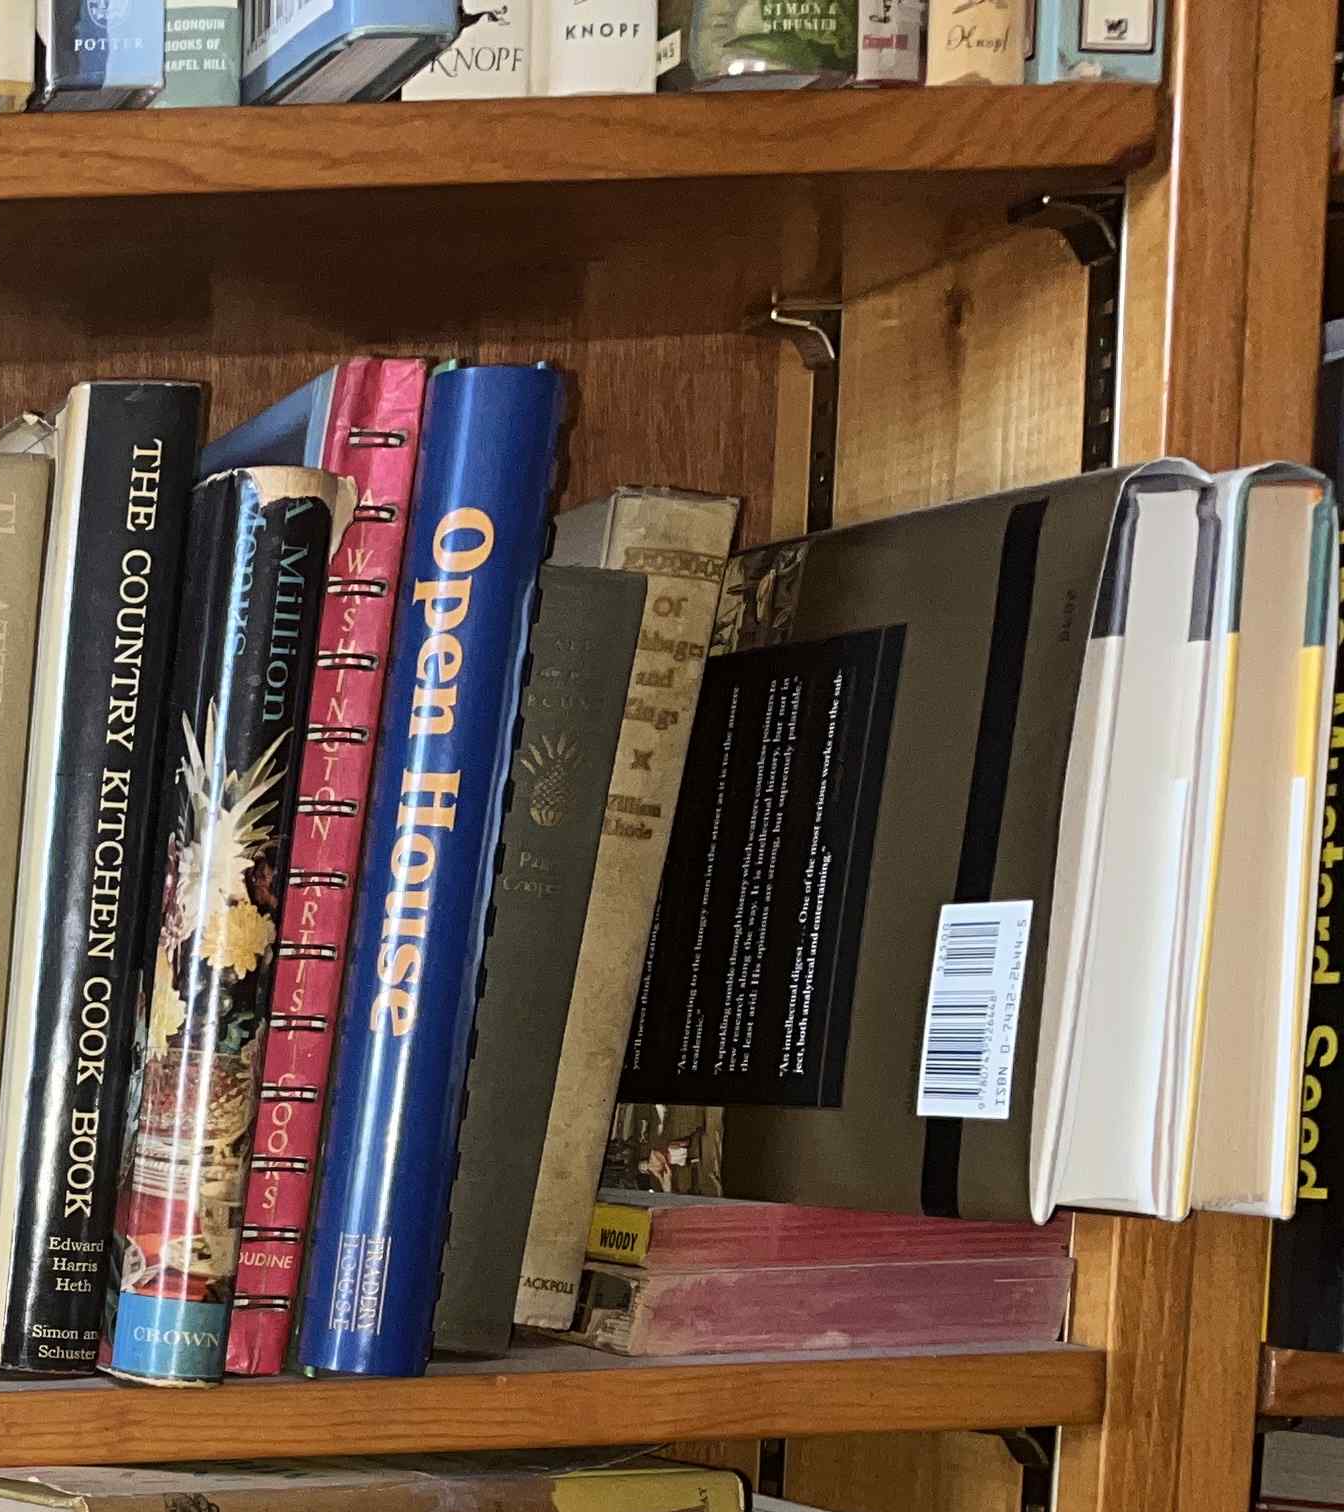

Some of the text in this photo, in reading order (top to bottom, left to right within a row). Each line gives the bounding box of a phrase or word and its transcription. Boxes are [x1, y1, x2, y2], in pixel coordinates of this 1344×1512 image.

[564, 22, 641, 41] KNOPF
[73, 37, 144, 52] POTTER
[429, 46, 524, 78] KNOPF
[370, 507, 496, 1038] Open House
[63, 439, 164, 1219] THE COUNTRY KITCHEN COOK BOOK
[48, 1238, 105, 1254] Edward
[599, 1228, 639, 1252] WOODY
[53, 1257, 99, 1275] Harris
[55, 1277, 92, 1293] Heth
